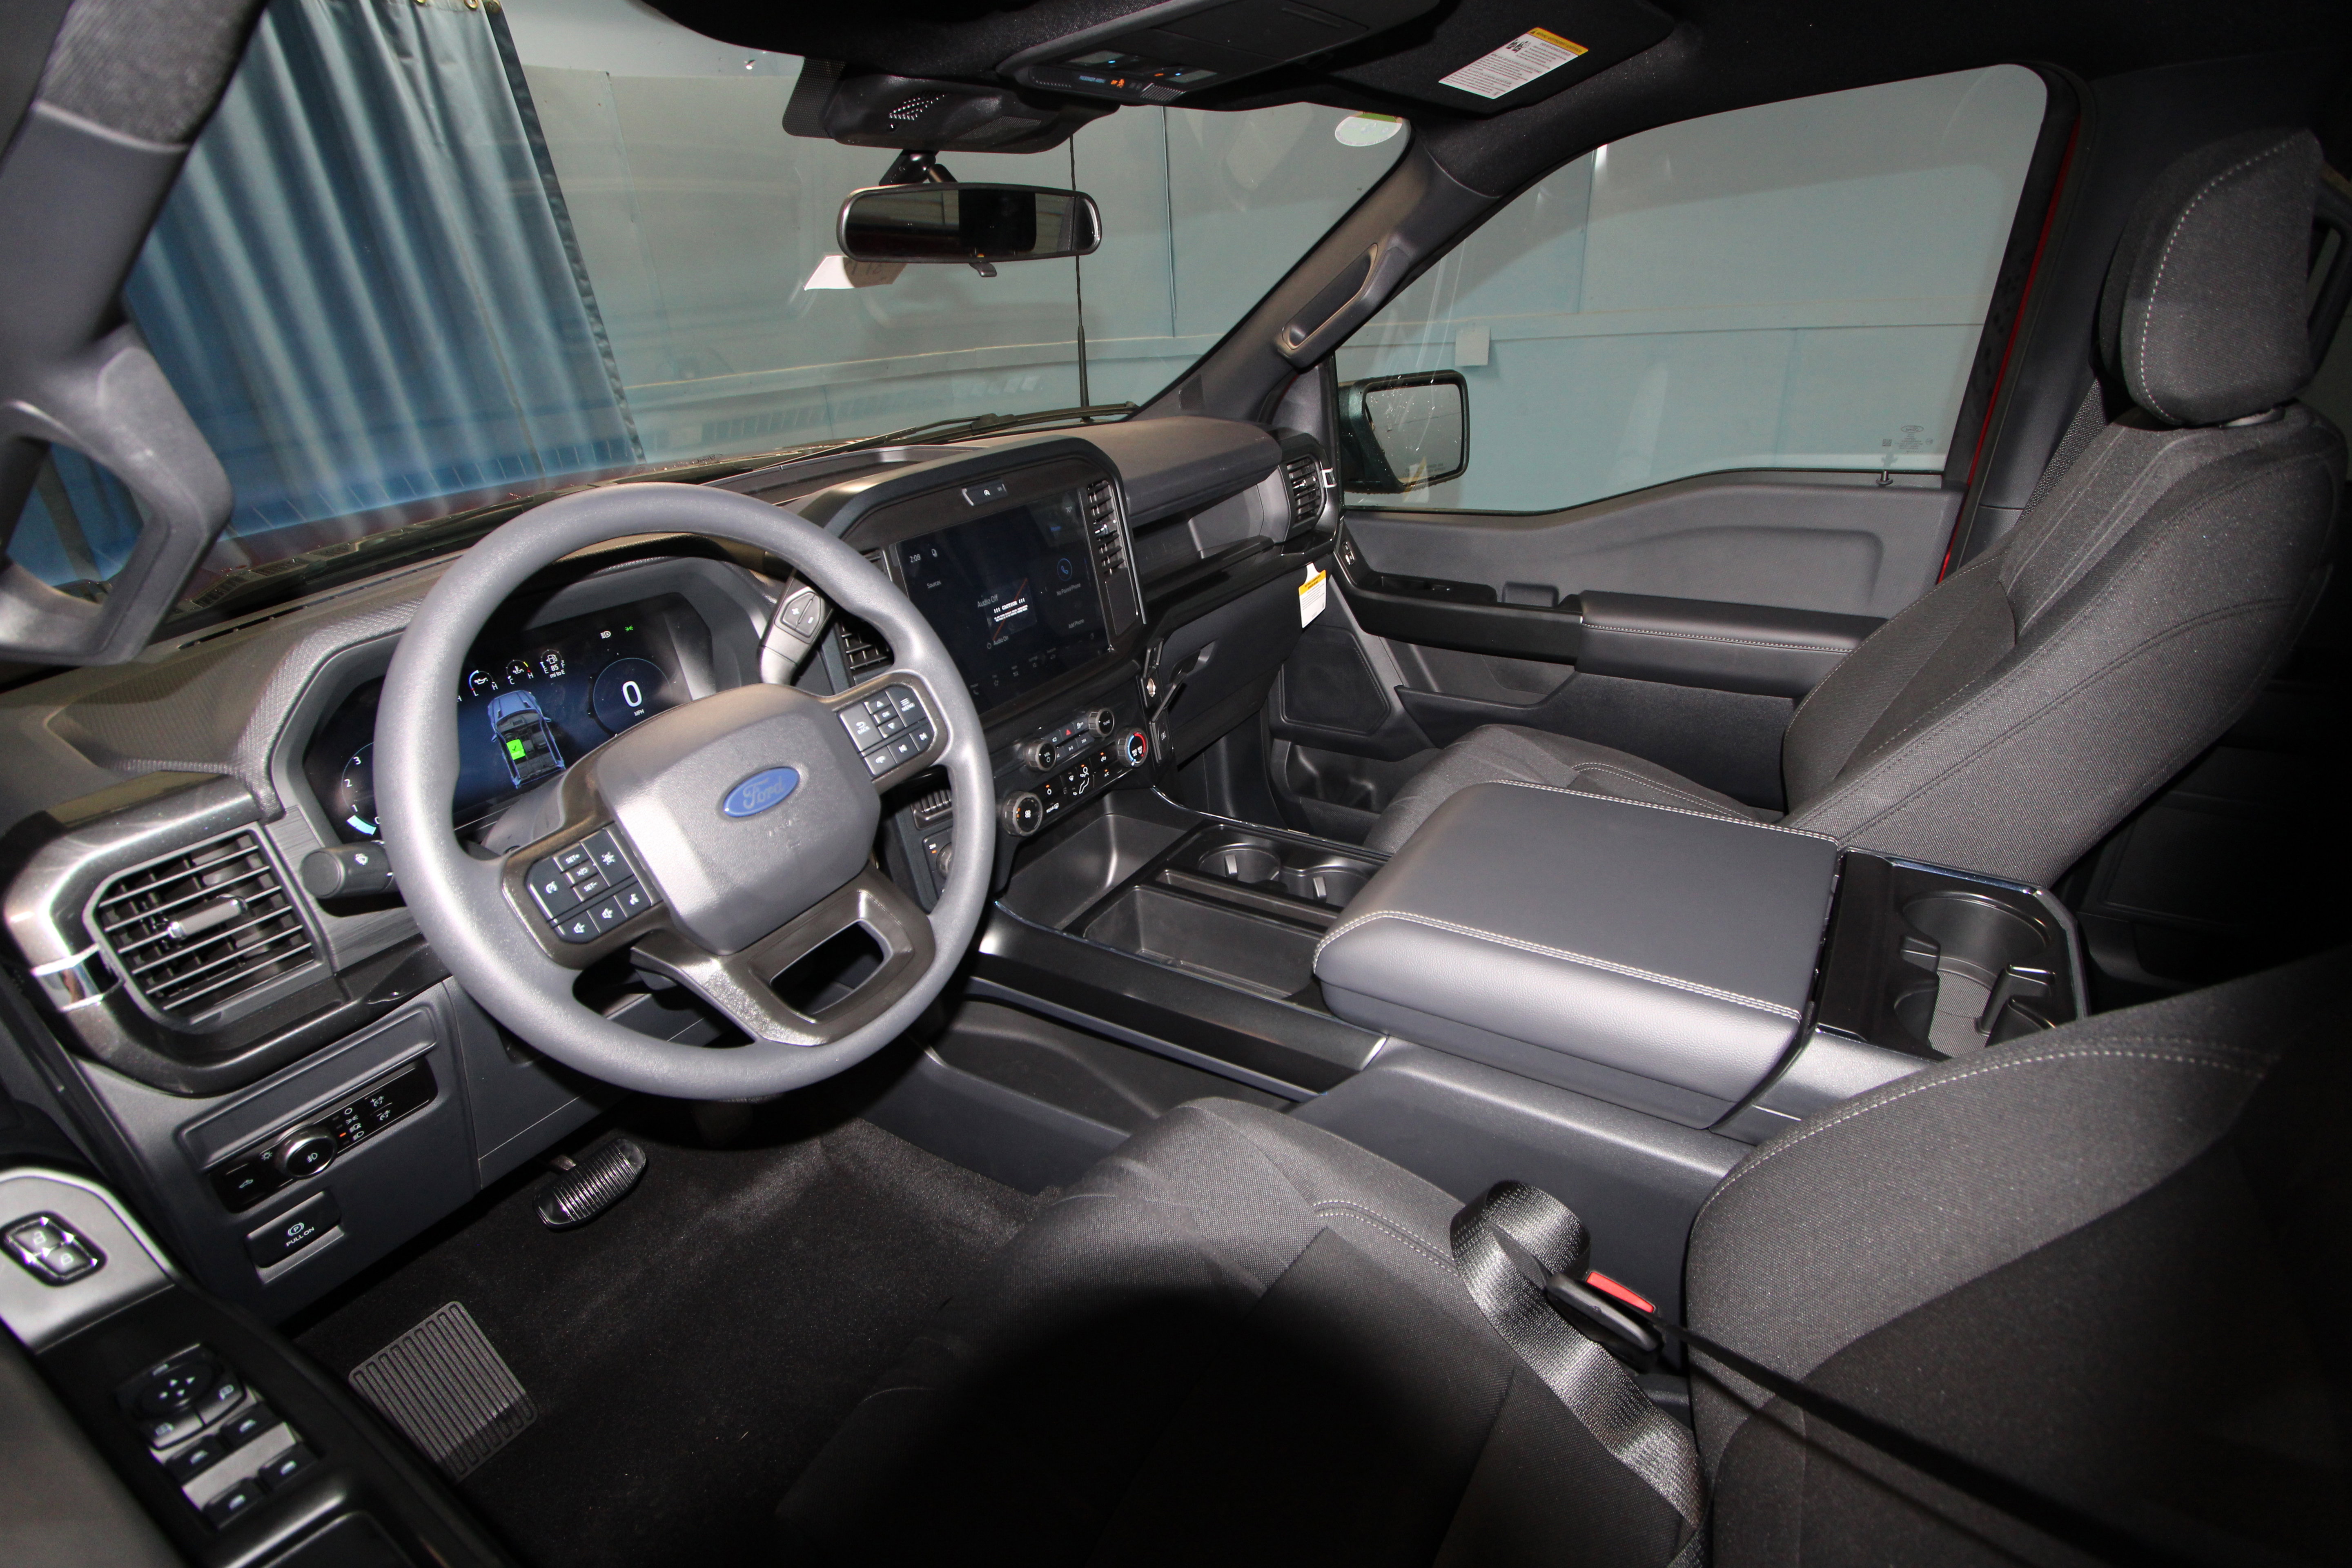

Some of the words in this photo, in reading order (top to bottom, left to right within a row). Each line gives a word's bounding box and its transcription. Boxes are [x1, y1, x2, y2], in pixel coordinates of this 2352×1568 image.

[909, 554, 921, 563] 2:08
[927, 580, 941, 588] Sources
[977, 598, 991, 608] Audio
[1001, 600, 1018, 610] CAUTION
[622, 680, 643, 707] 0
[901, 702, 915, 712] MENU
[857, 725, 871, 735] BACK
[353, 756, 361, 765] 3
[344, 778, 352, 788] 2
[743, 777, 784, 809] Ford
[352, 804, 358, 812] 1
[285, 1234, 304, 1247] PULL
[303, 1226, 314, 1236] ON
